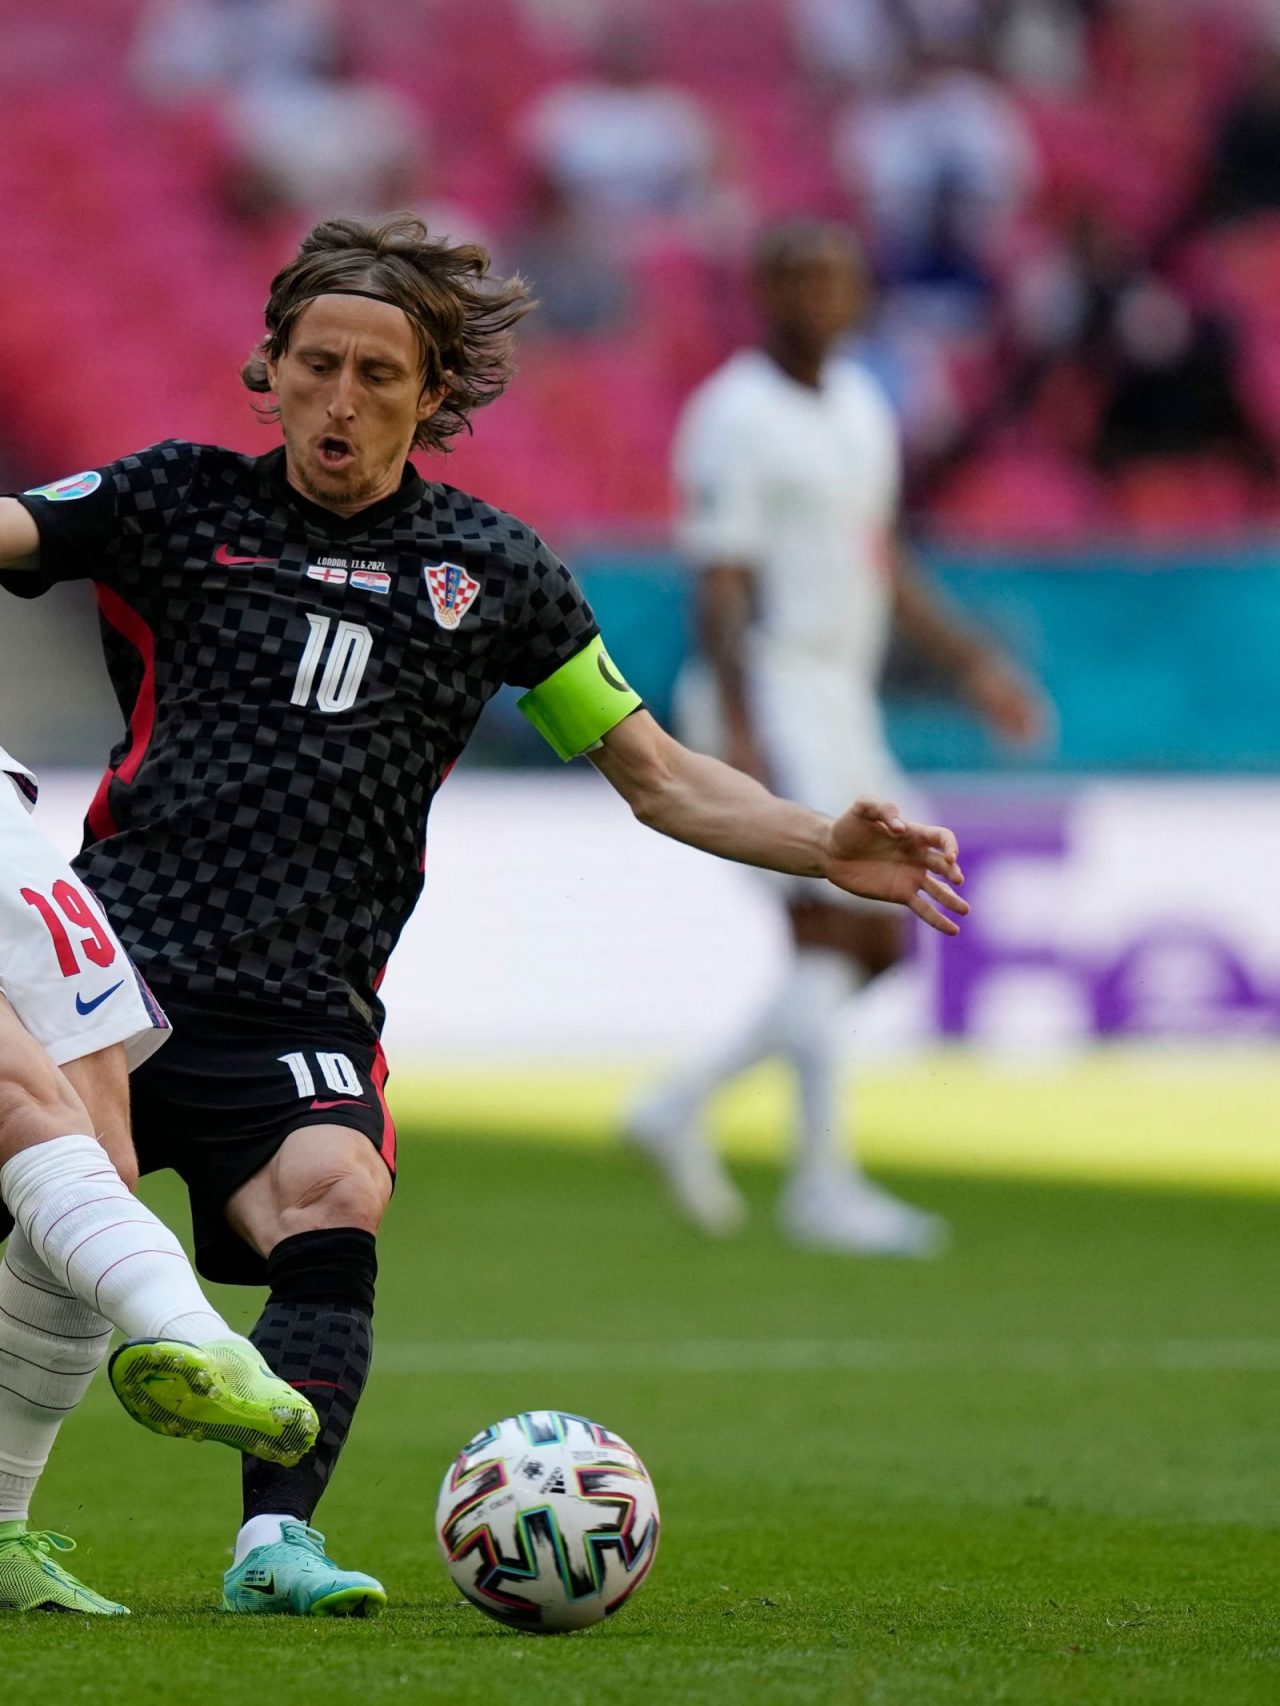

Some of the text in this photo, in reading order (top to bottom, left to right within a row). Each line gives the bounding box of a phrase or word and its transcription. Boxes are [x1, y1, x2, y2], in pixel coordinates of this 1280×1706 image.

[290, 612, 373, 713] 10
[20, 879, 116, 978] 19
[277, 1051, 364, 1099] 10
